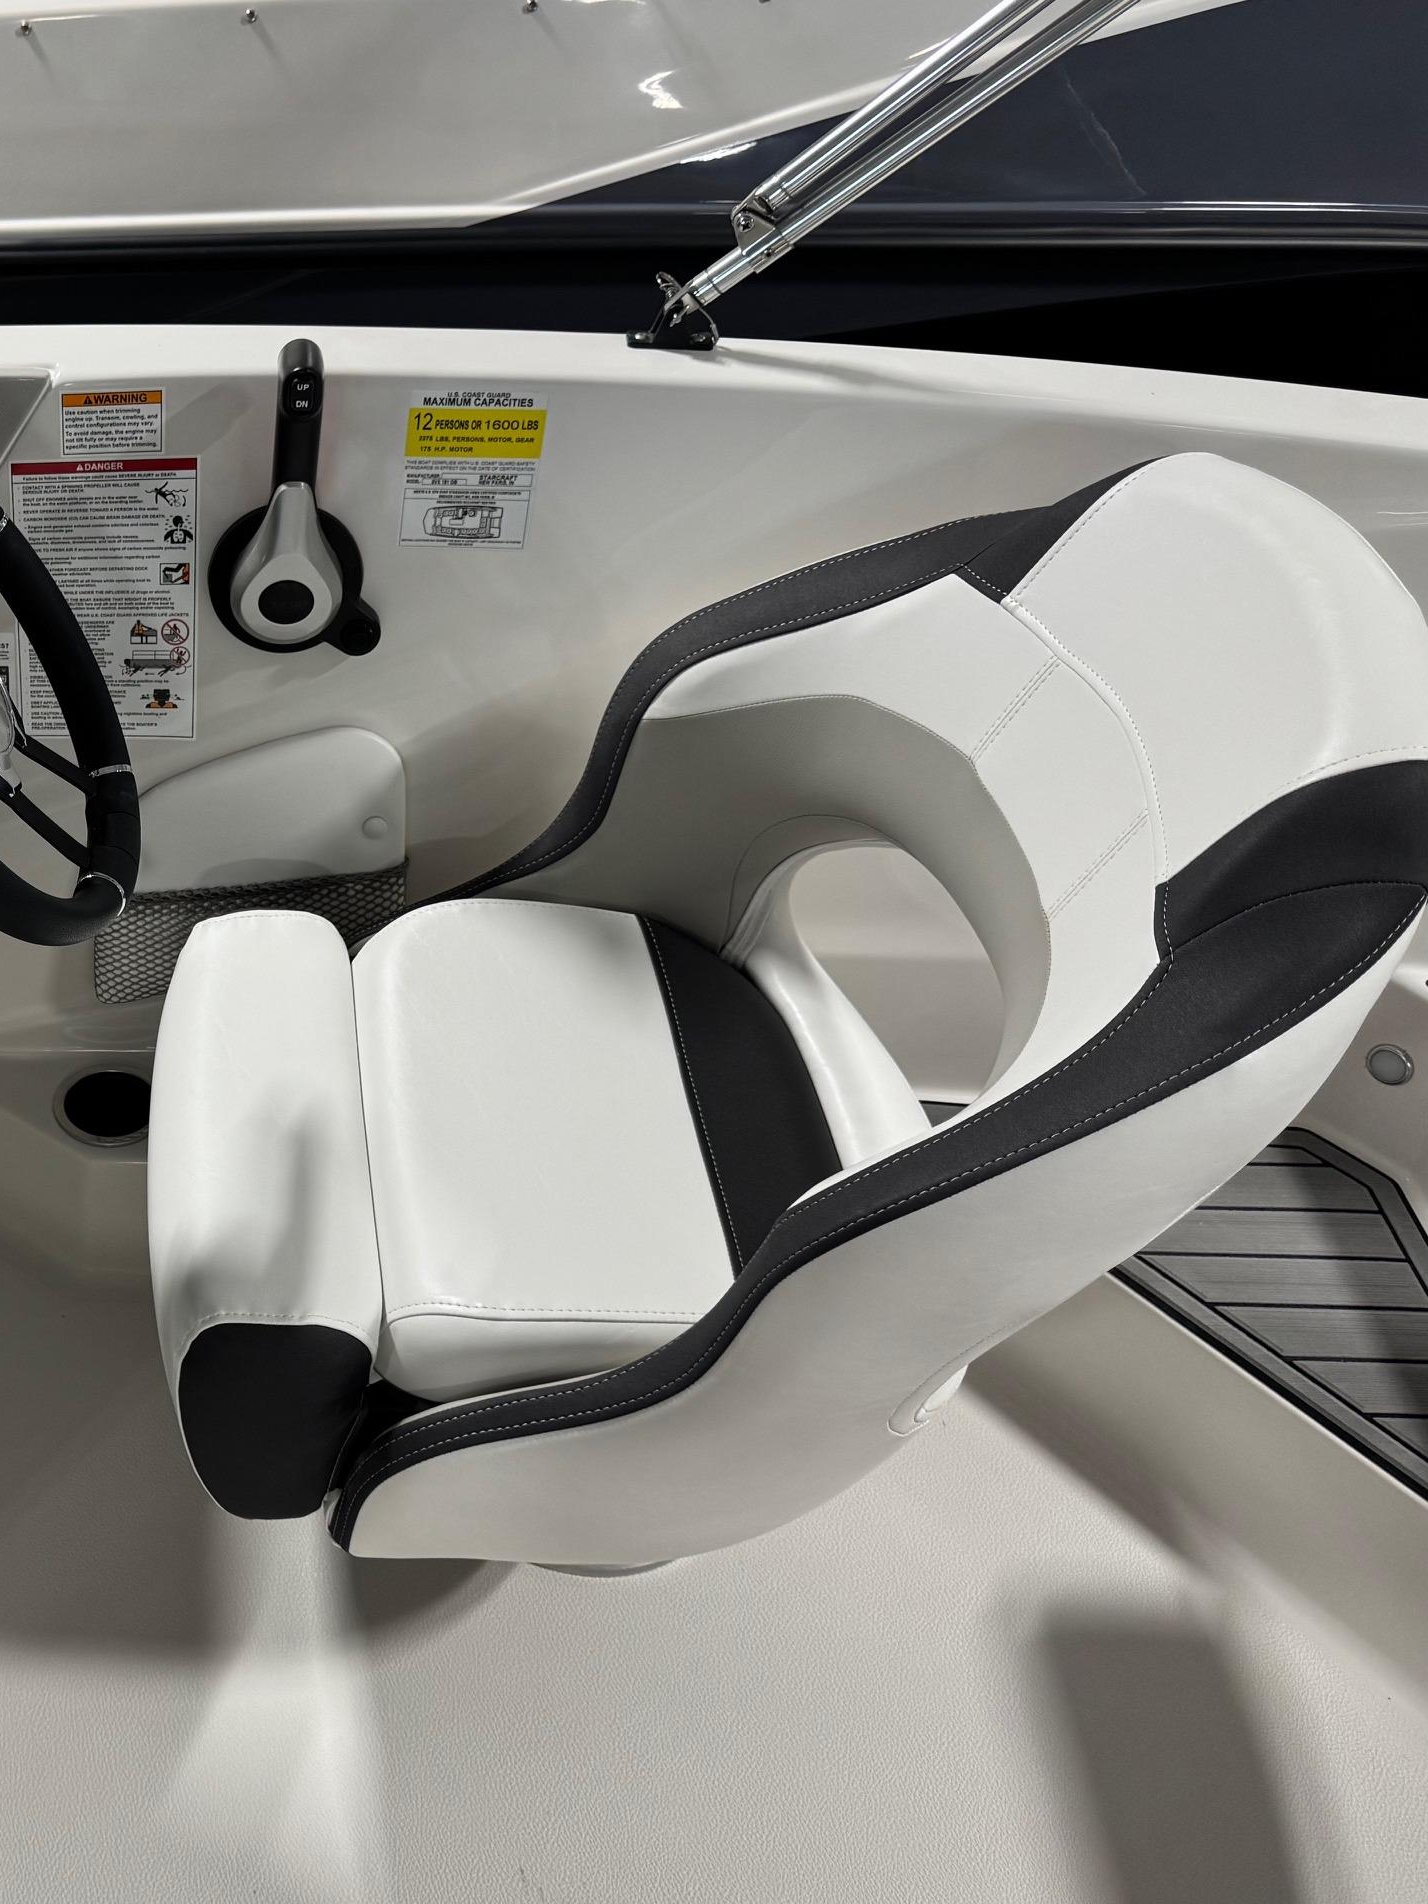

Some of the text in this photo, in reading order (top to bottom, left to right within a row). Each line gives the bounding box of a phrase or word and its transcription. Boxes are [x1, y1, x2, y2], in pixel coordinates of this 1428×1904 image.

[94, 393, 147, 404] WARNING
[423, 397, 533, 407] MAXIMUM CAPACITIES
[414, 412, 538, 430] 12 PERSONS OR 1600 LBS
[85, 462, 123, 471] DANGER
